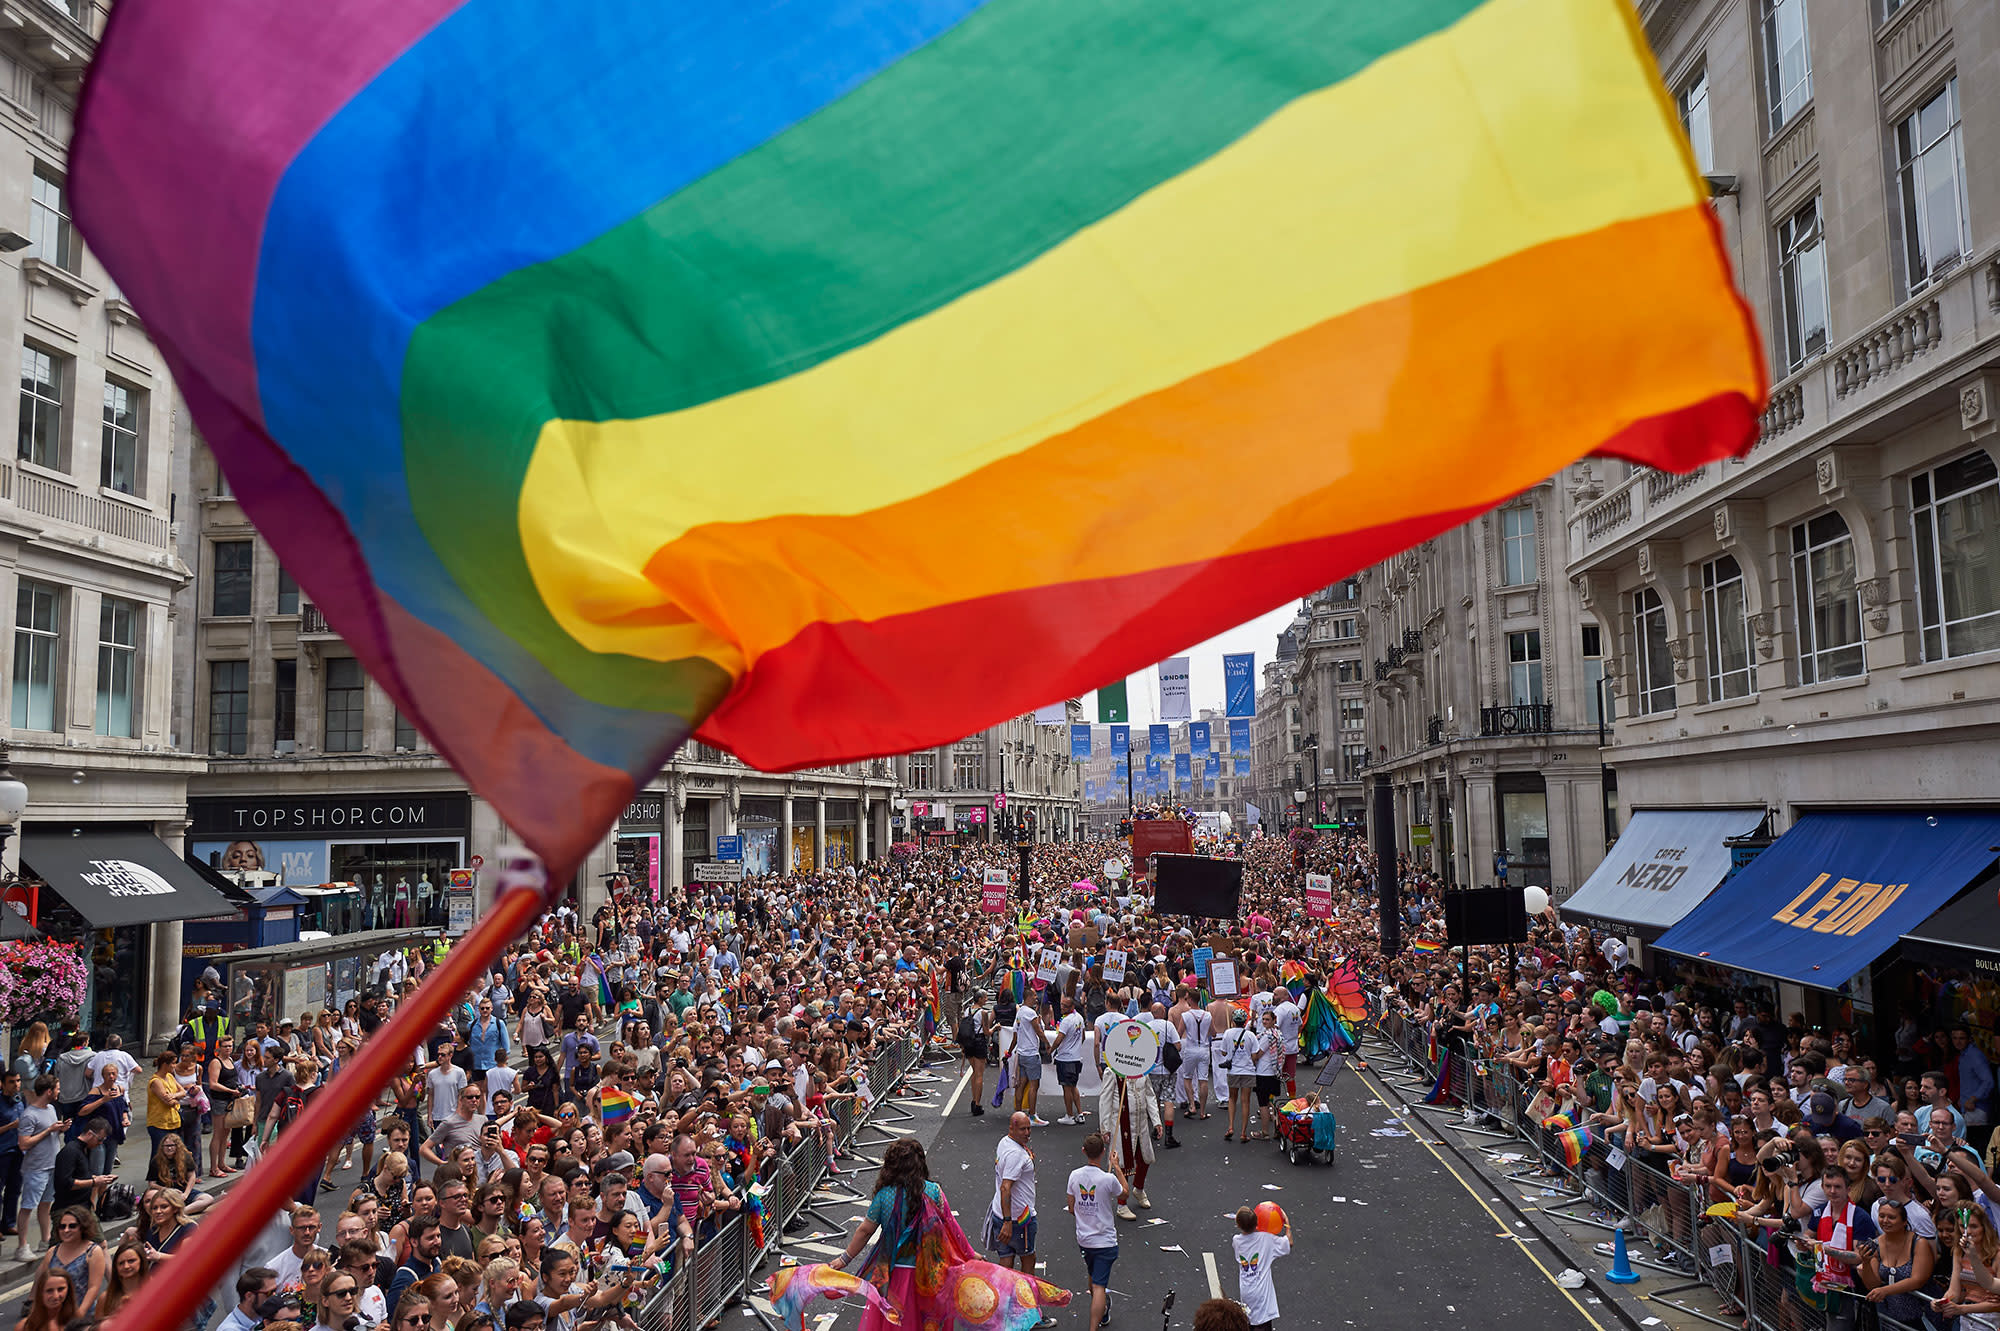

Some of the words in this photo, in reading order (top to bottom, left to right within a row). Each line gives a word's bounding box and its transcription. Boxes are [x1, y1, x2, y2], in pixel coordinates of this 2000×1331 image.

[694, 777, 715, 788] TOPSHOP
[234, 806, 425, 827] TOPSHOP.COM
[624, 803, 660, 819] OPSHOP
[281, 852, 313, 867] IVY
[1655, 847, 1687, 861] CAFFÈ
[89, 860, 125, 872] THE
[80, 872, 138, 886] NORTH
[1616, 862, 1688, 892] NERO
[108, 884, 152, 896] FACE
[983, 891, 1006, 899] CROSSING
[1555, 886, 1568, 894] 271
[1307, 896, 1330, 905] CROSSING
[1771, 872, 1909, 936] LEON
[1312, 904, 1325, 912] POINT
[1612, 923, 1627, 934] COFFEE
[1976, 959, 2000, 972] BOULA
[1115, 1057, 1142, 1068] Foundation
